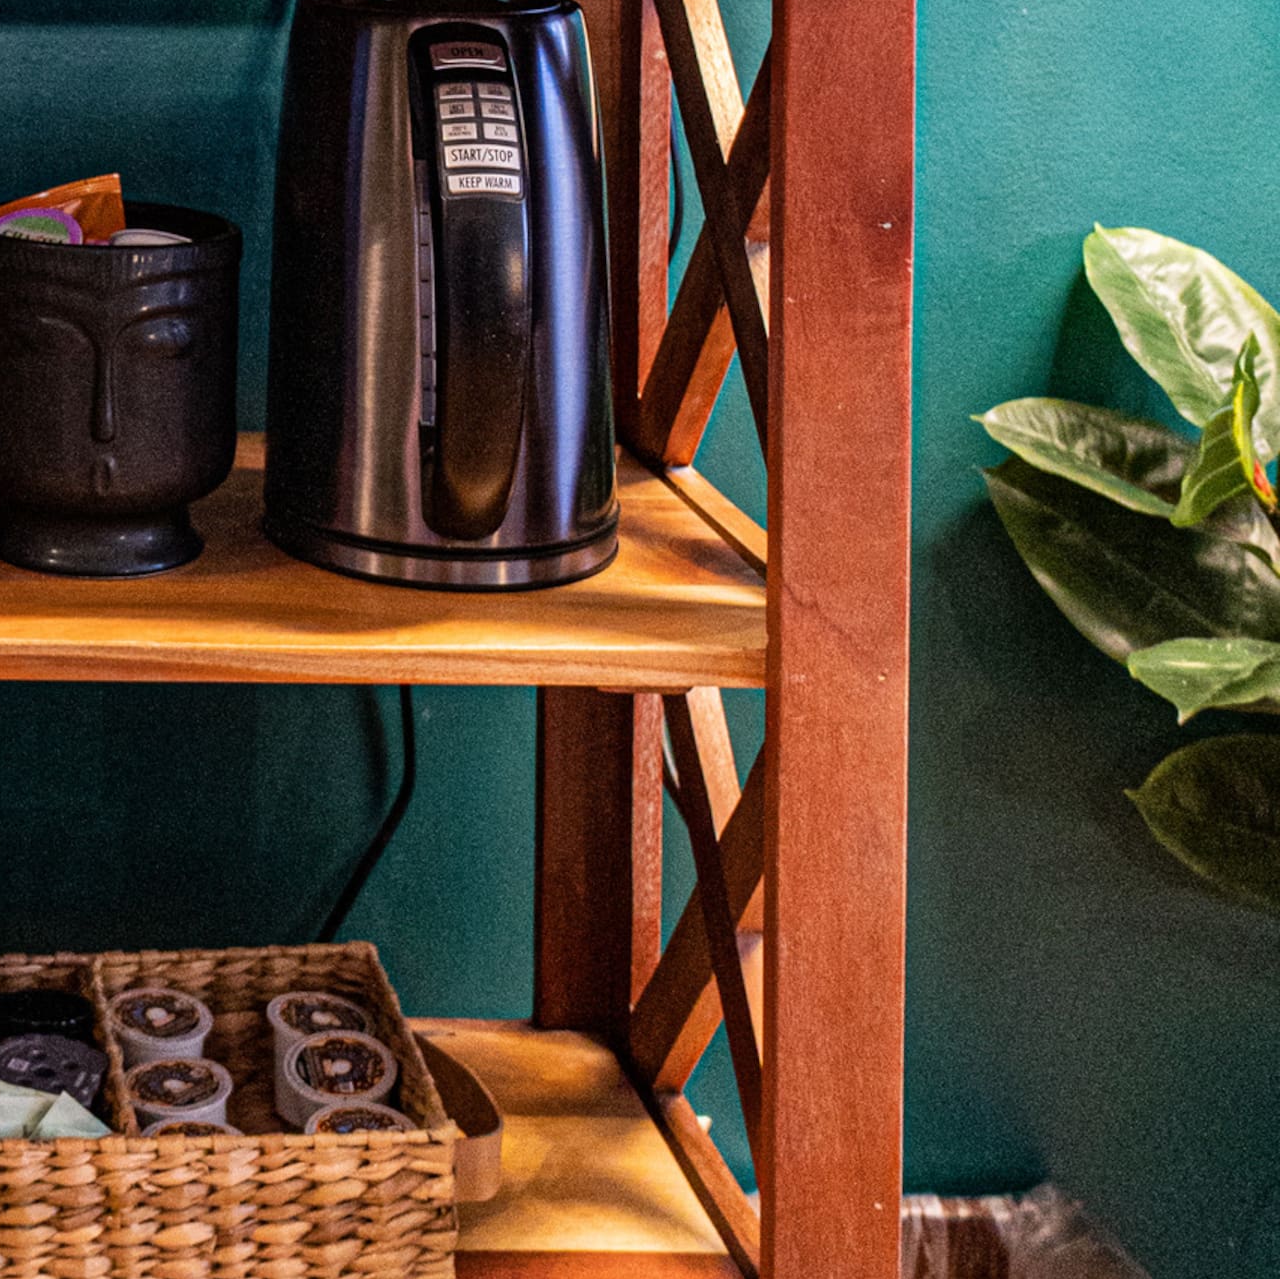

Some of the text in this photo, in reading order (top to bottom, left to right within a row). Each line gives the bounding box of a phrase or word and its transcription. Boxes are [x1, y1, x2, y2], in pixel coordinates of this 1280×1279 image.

[450, 46, 484, 57] OPEN
[451, 148, 514, 163] START/STOP
[458, 175, 513, 190] KEEP WARM
